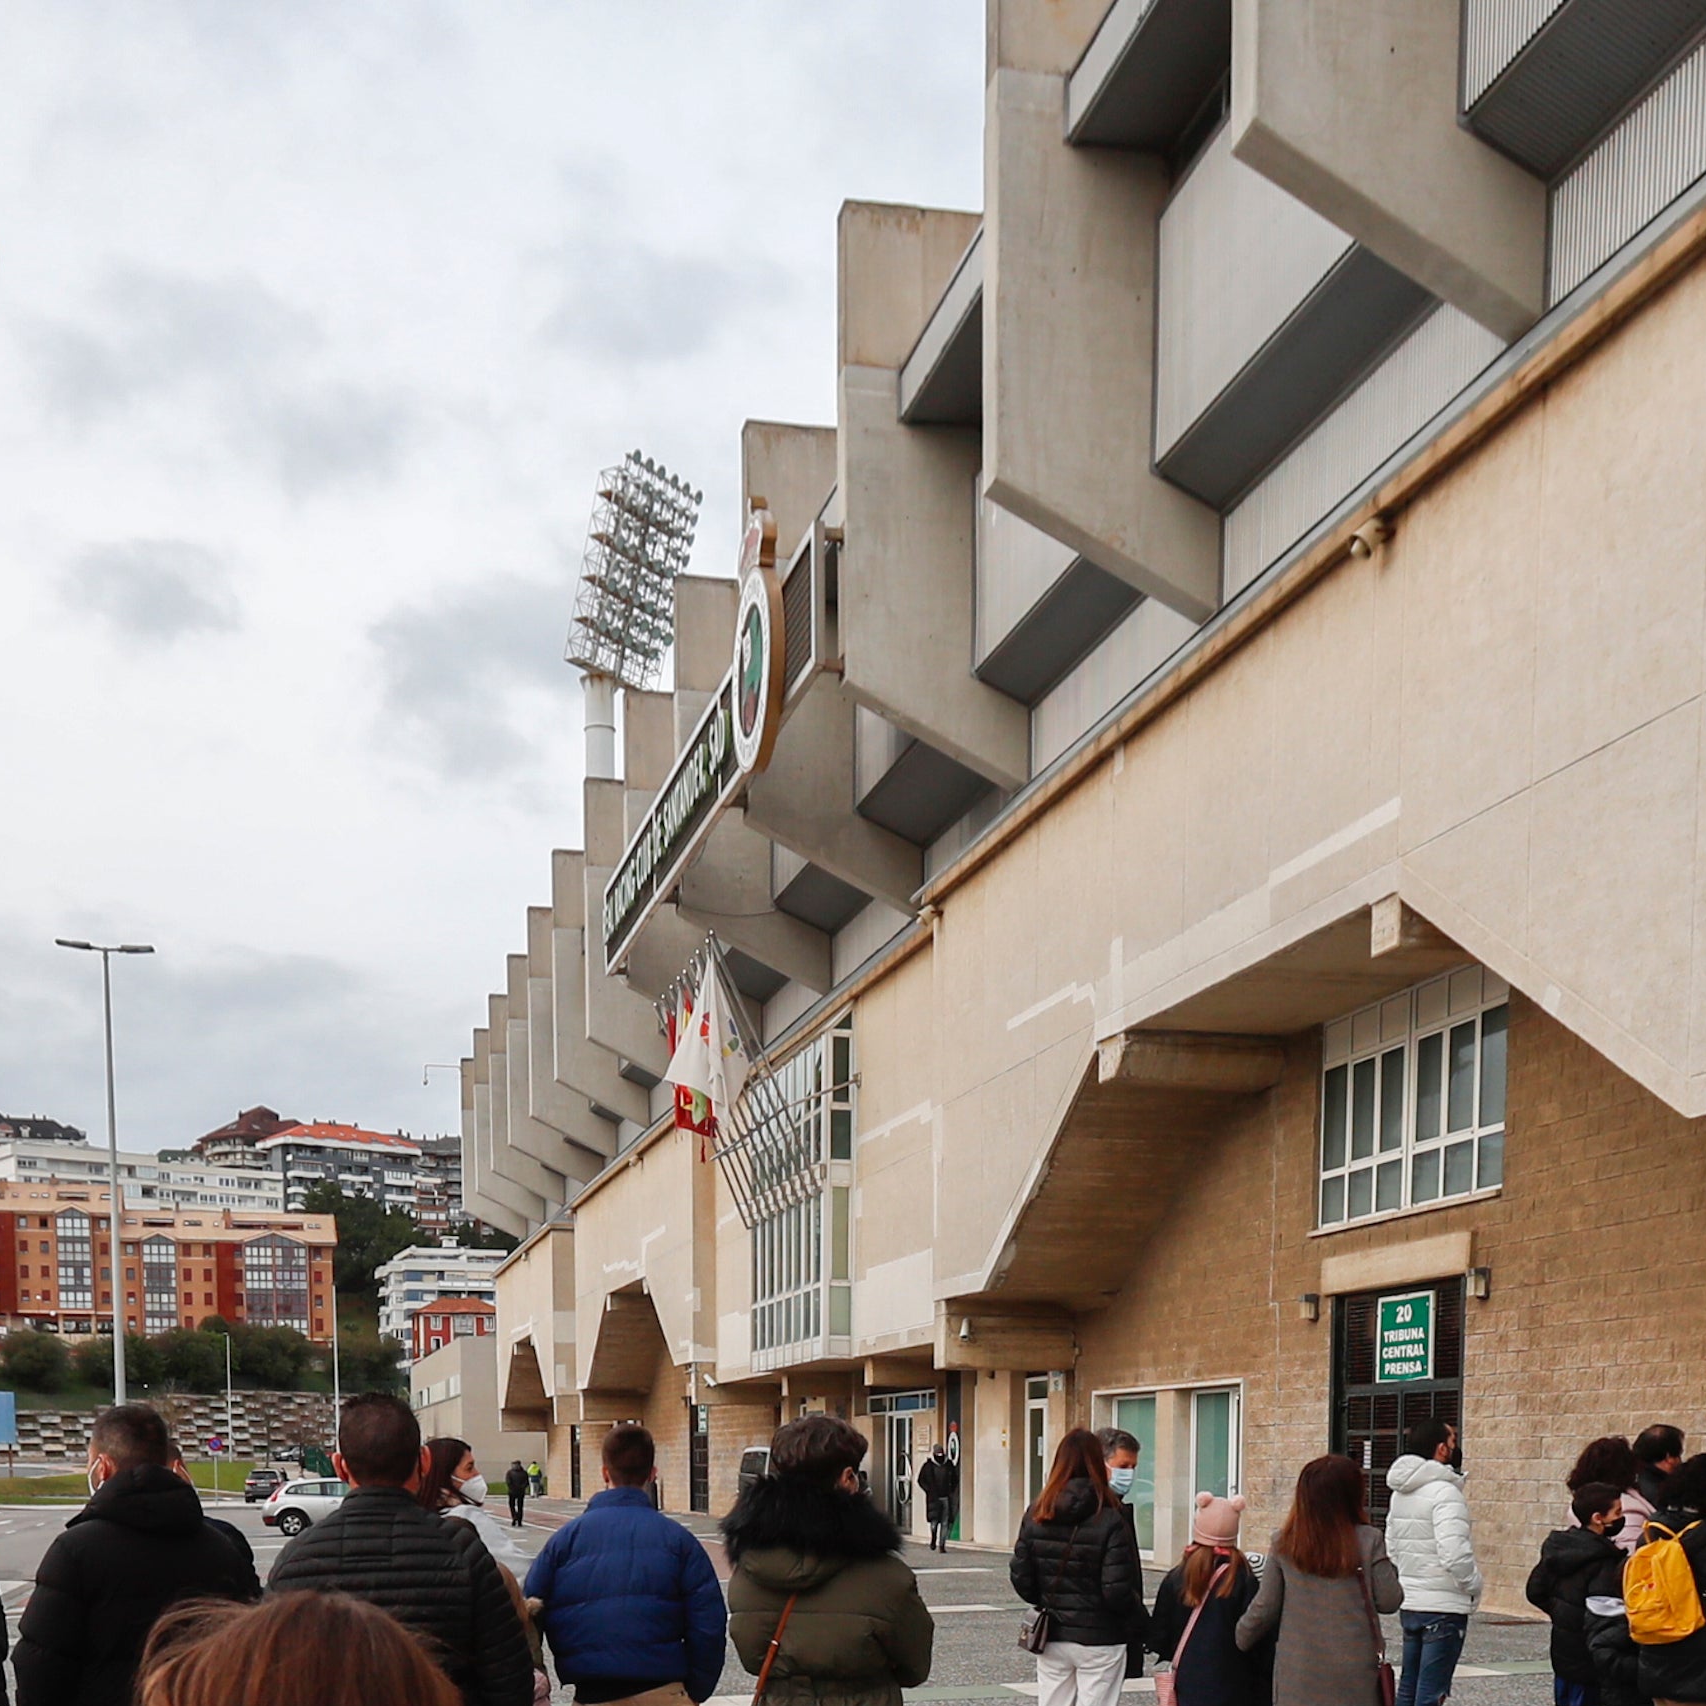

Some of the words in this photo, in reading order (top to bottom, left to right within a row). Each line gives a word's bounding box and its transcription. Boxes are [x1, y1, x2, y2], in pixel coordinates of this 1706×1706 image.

[1396, 1304, 1413, 1324] 20
[1384, 1327, 1425, 1343] TRIBUNA
[1382, 1343, 1425, 1359] CENTRAL
[1384, 1360, 1422, 1375] PRENSA
